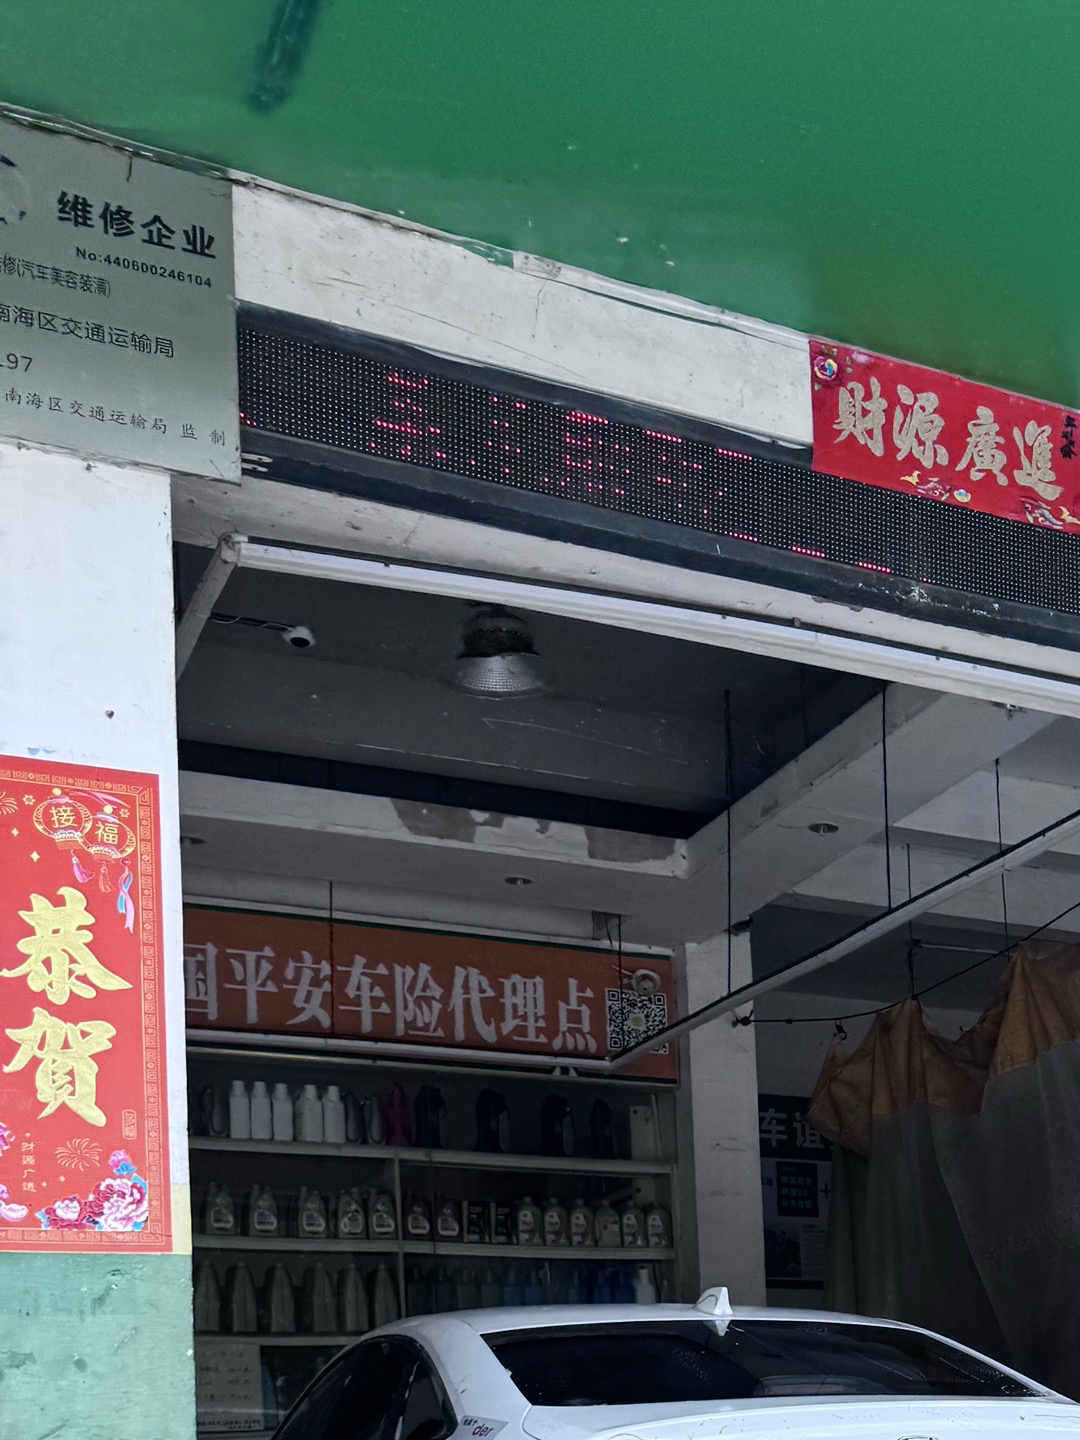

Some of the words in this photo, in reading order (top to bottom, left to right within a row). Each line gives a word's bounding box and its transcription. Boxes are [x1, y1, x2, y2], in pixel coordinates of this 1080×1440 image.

[57, 190, 217, 259] 维修企业
[0, 253, 111, 298] 修(汽车美容装潢)
[76, 246, 212, 289] No:440600246104
[5, 387, 167, 434] 南海区交通运输局
[833, 376, 1064, 501] 財源廣進
